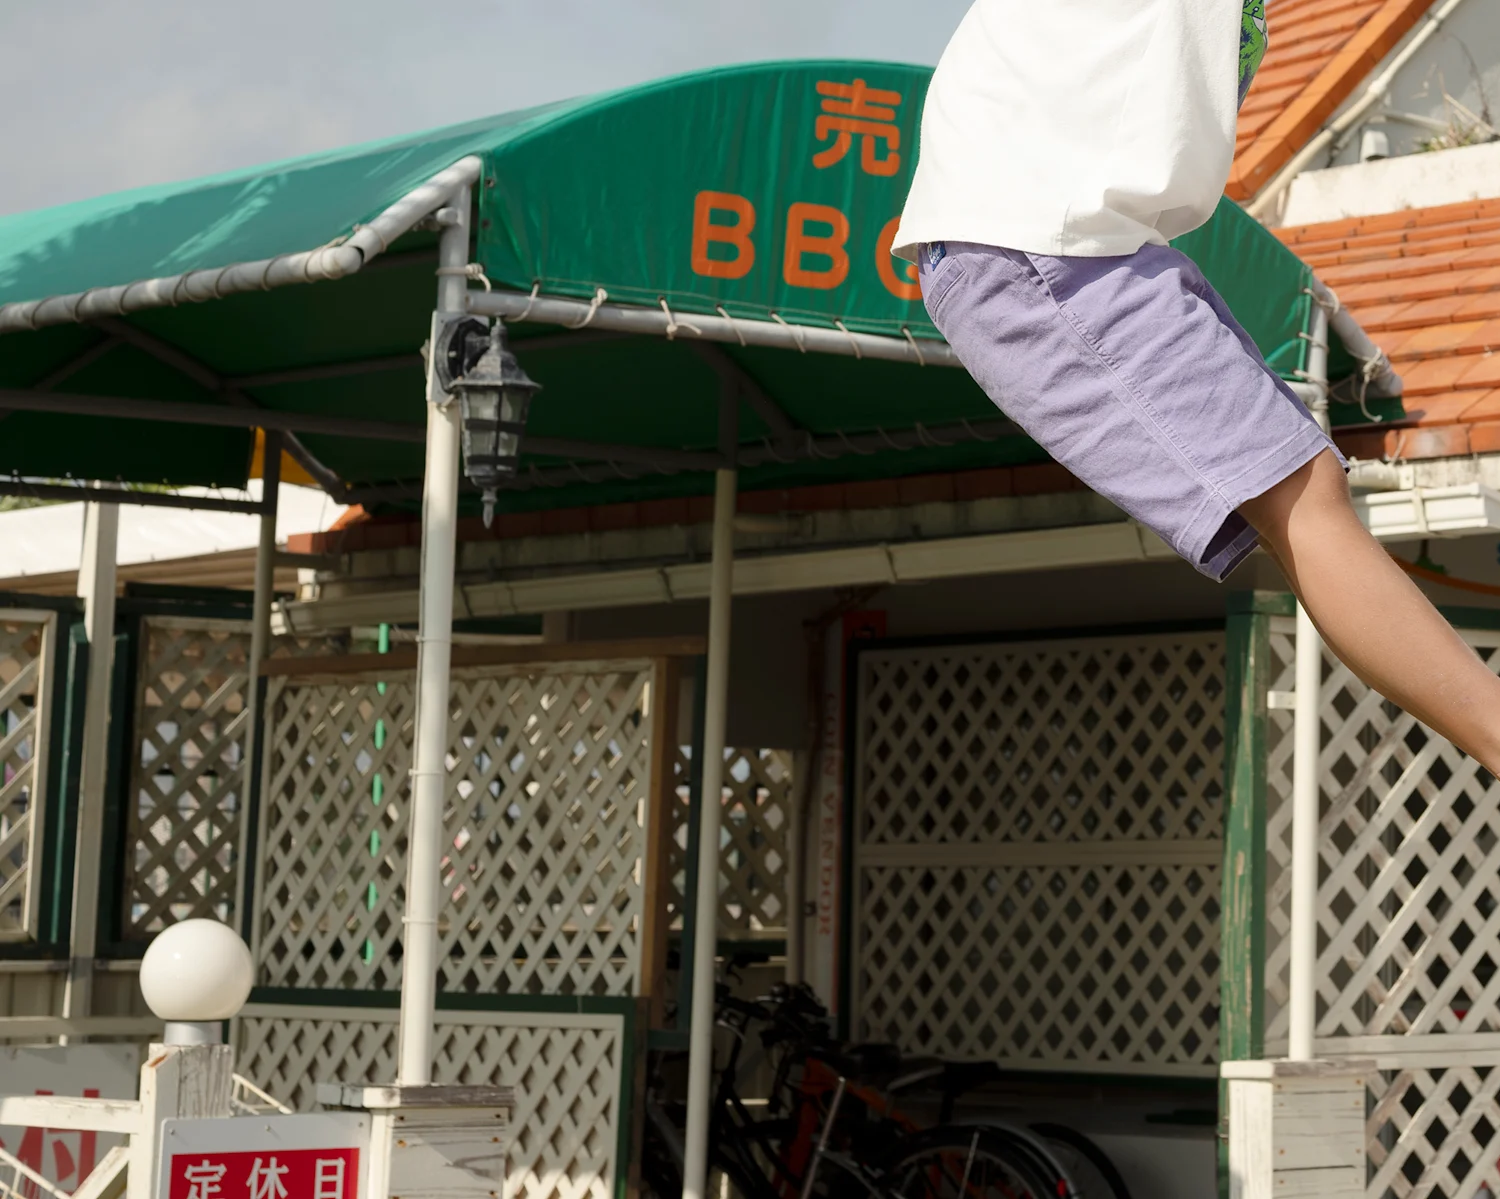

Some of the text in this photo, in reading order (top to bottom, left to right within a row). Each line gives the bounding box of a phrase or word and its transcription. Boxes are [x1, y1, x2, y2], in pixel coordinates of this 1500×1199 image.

[812, 78, 903, 177] 売
[818, 692, 837, 937] COIN VENDOR
[184, 1156, 346, 1199] 定休日
